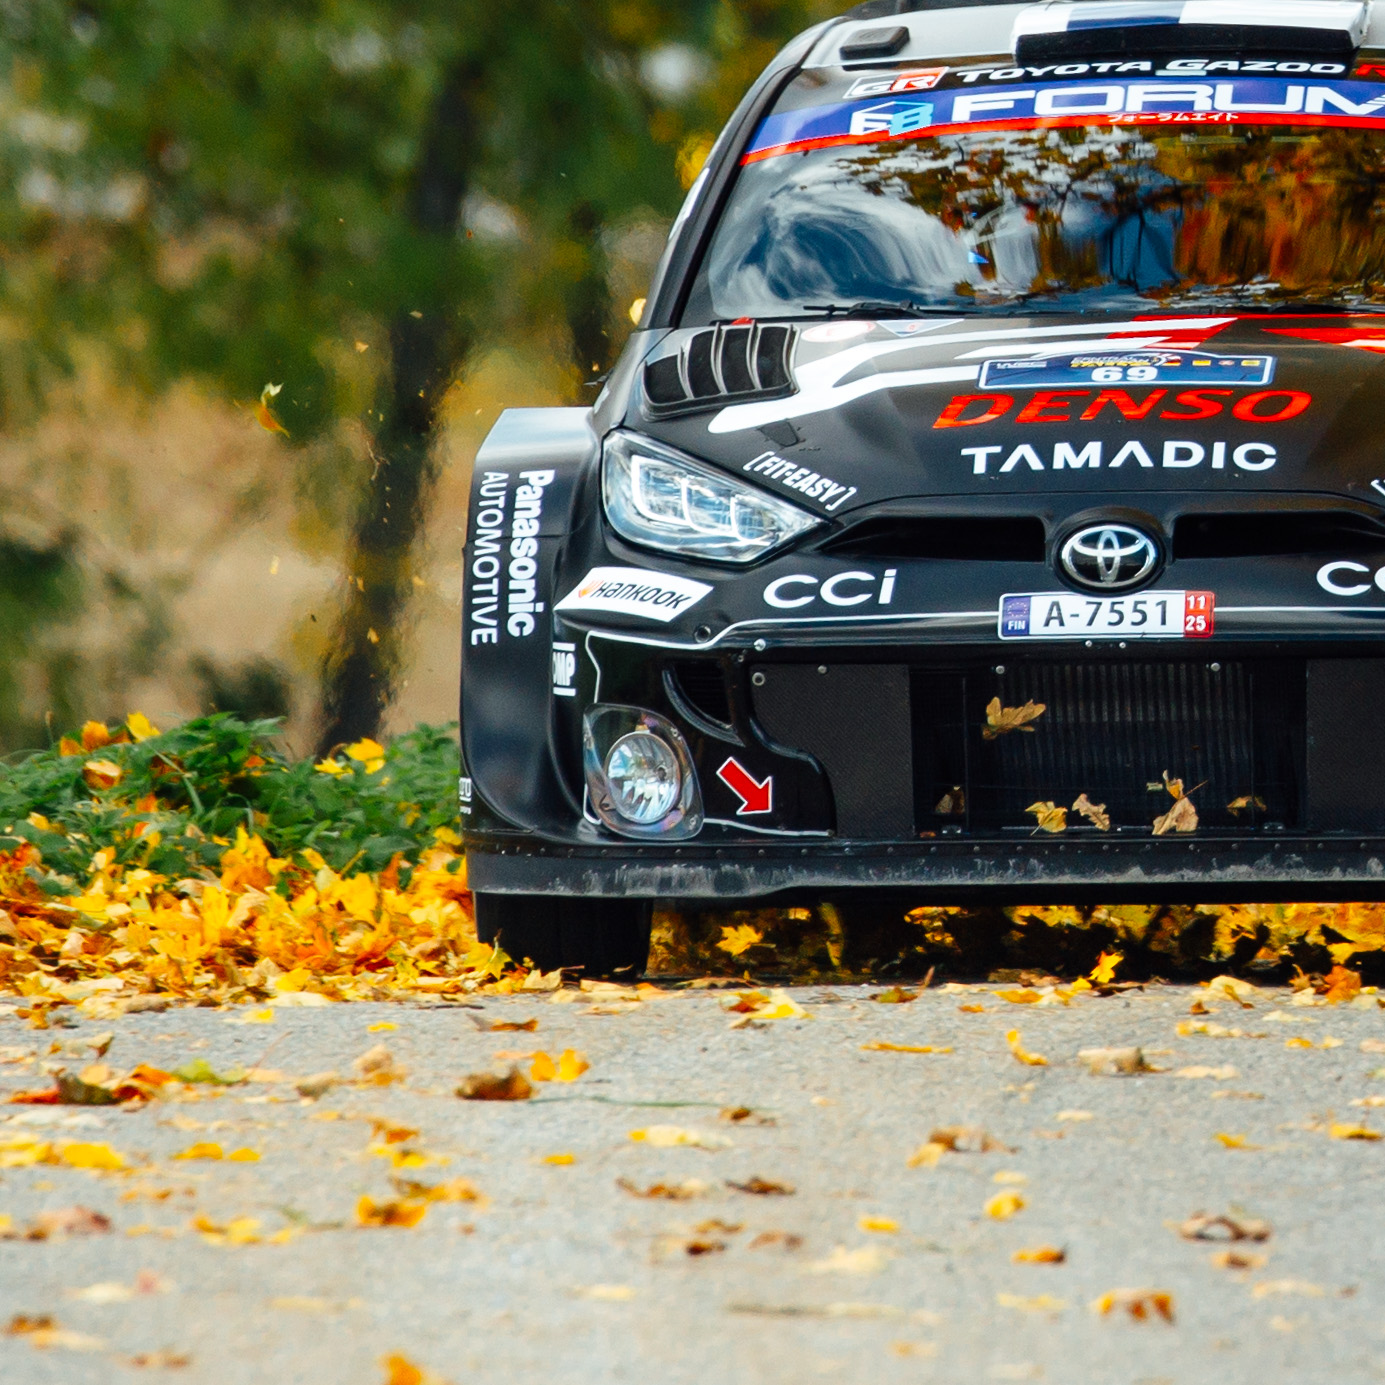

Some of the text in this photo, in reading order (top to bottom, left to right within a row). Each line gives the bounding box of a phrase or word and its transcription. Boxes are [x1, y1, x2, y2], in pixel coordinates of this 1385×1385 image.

[851, 75, 936, 95] GR
[957, 61, 1152, 83] TOYOTA
[1166, 59, 1345, 73] GAZOO
[1108, 112, 1239, 123] フォーラムエイト
[1091, 366, 1158, 382] 69
[932, 389, 1312, 429] DENSO
[961, 440, 1276, 474] TAMADIC
[470, 471, 509, 646] AUTOMOTIVE
[507, 469, 556, 638] Panasonic
[1043, 600, 1167, 627] A-7551
[1187, 595, 1205, 610] 11
[1008, 620, 1025, 630] FIN
[1185, 615, 1206, 631] 25
